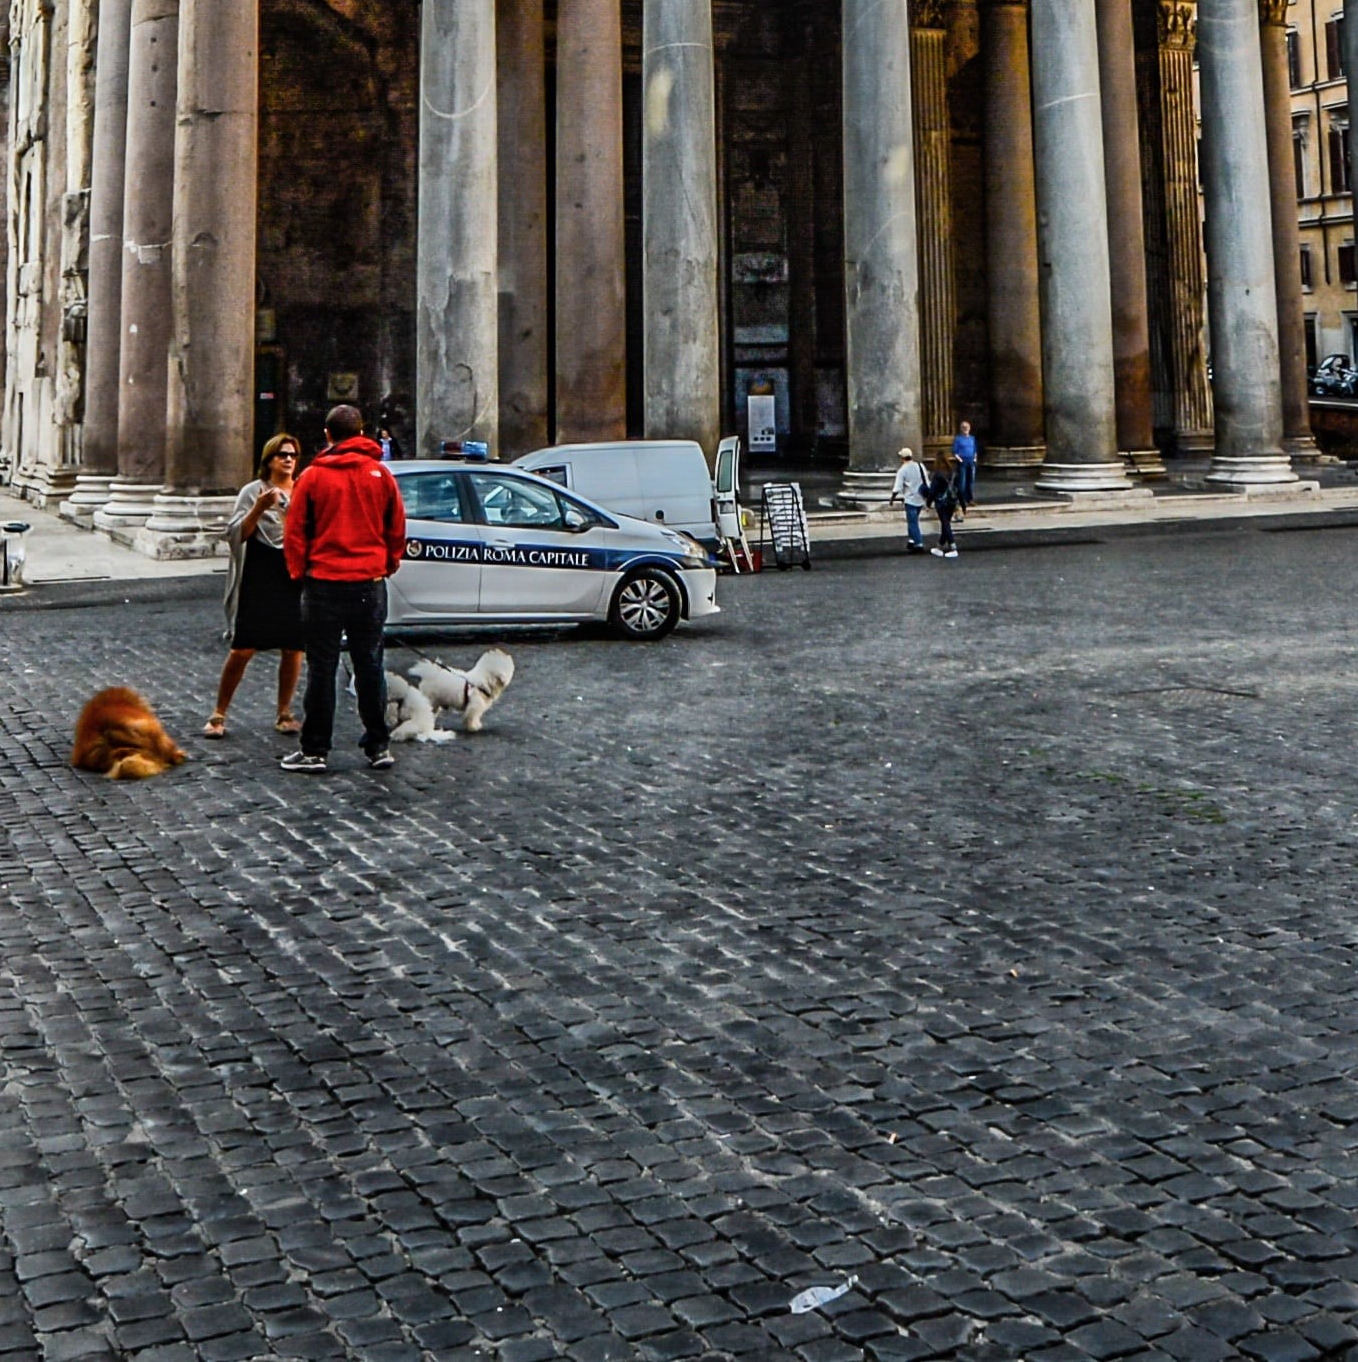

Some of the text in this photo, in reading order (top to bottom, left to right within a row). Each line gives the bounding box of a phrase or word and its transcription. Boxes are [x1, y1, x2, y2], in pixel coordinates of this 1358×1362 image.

[425, 545, 589, 566] POLIZIA ROMA CAPITALE
